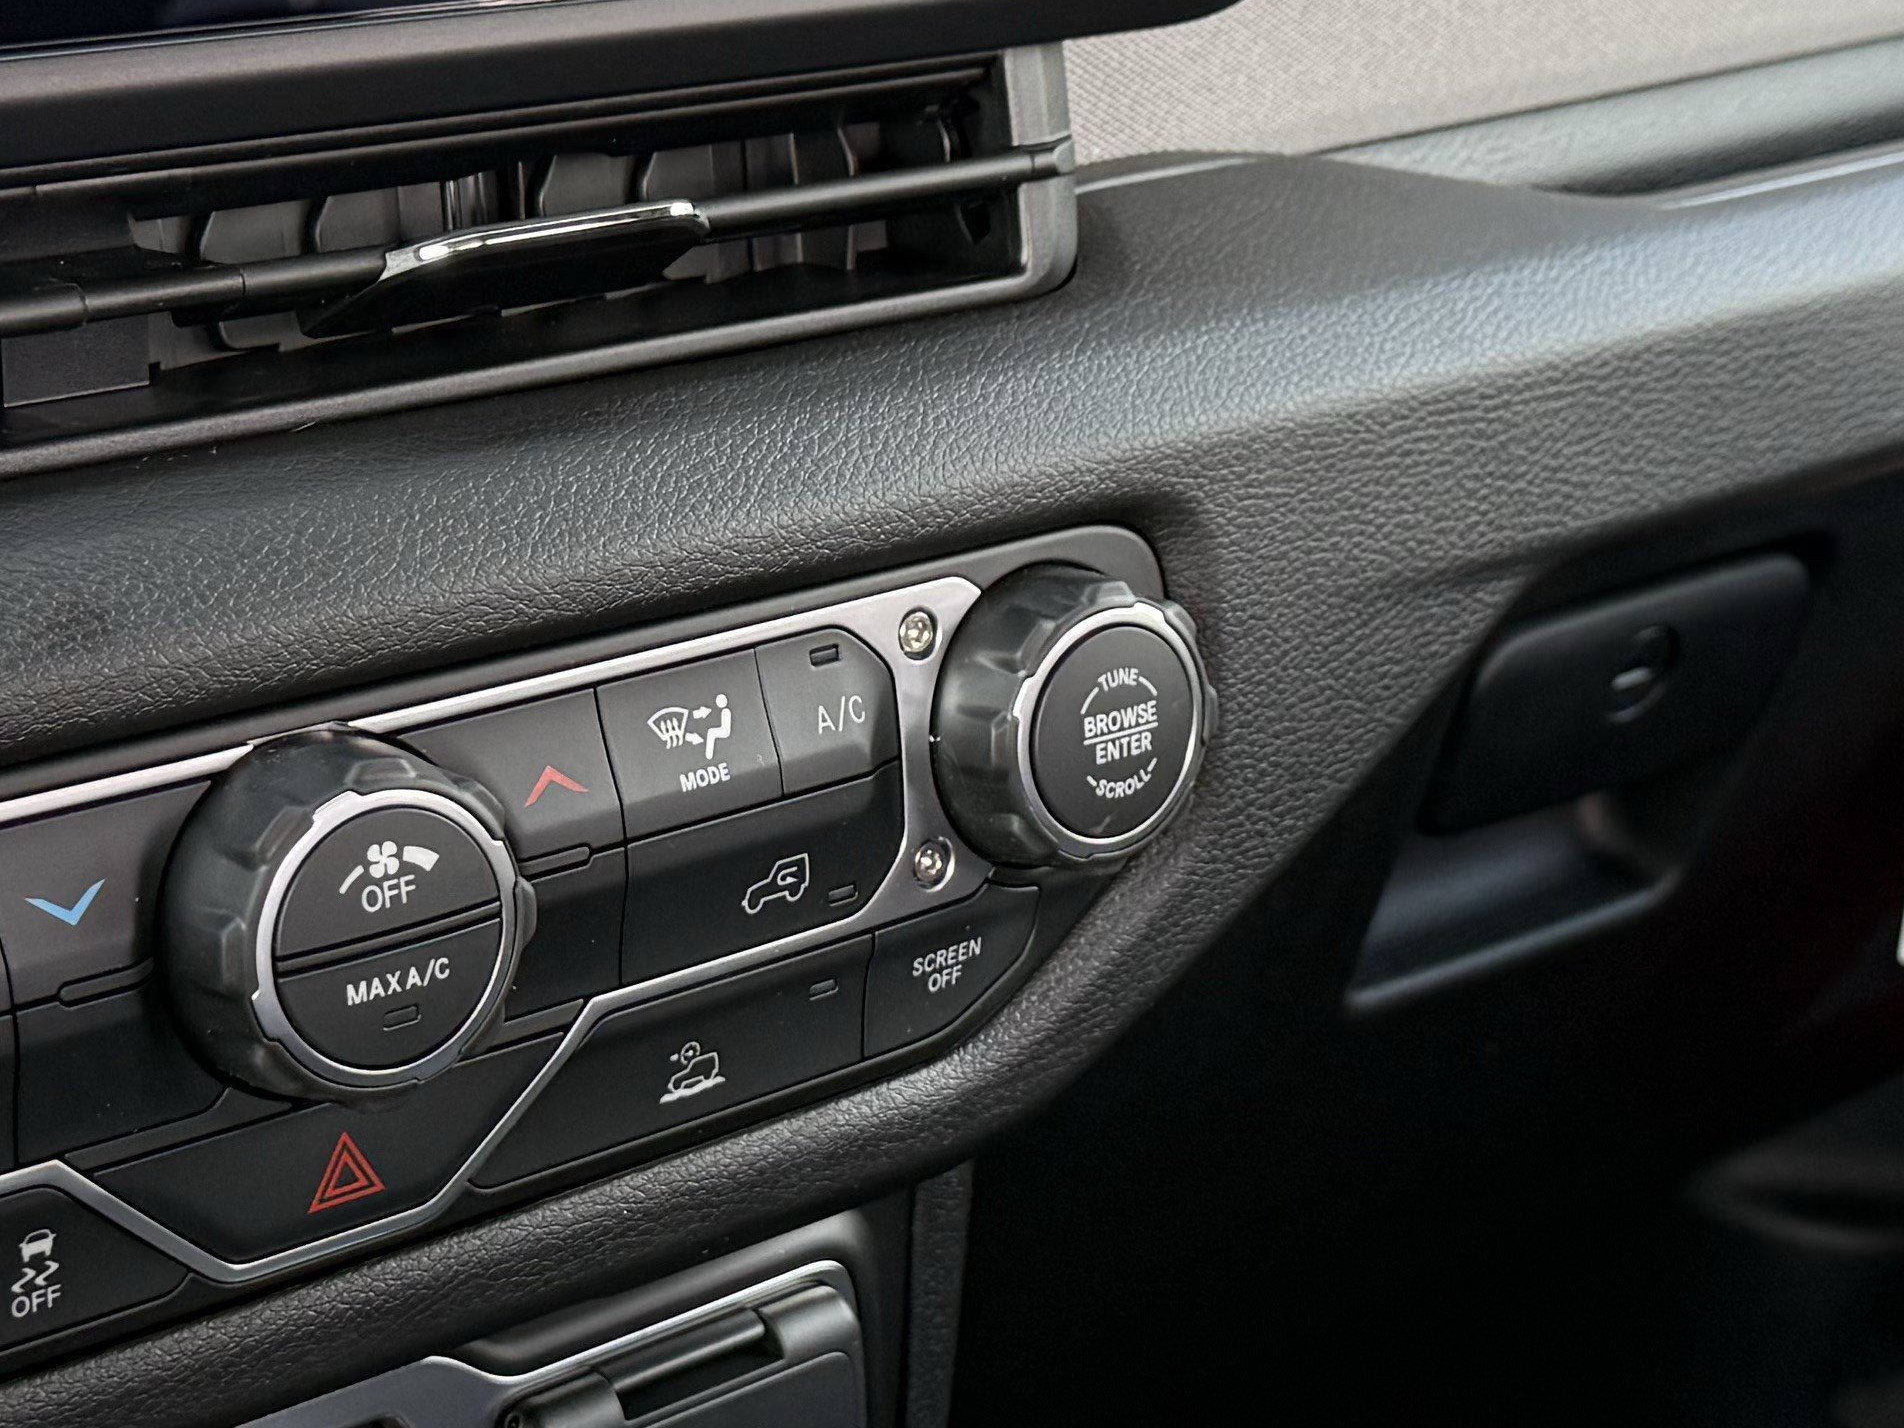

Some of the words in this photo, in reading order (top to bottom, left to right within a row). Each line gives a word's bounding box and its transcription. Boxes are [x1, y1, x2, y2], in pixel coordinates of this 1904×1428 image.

[1097, 667, 1141, 693] TUNE
[816, 694, 867, 736] A/C
[1082, 700, 1159, 738] BROWSE
[1094, 731, 1154, 765] ENTER
[679, 764, 732, 794] MODE
[1093, 768, 1153, 800] SCROLL
[360, 878, 417, 914] OFF
[911, 935, 983, 979] SCREEN
[345, 971, 403, 1008] MAX
[404, 956, 452, 993] A/C
[927, 963, 963, 994] OFF
[10, 1284, 62, 1319] OFF
